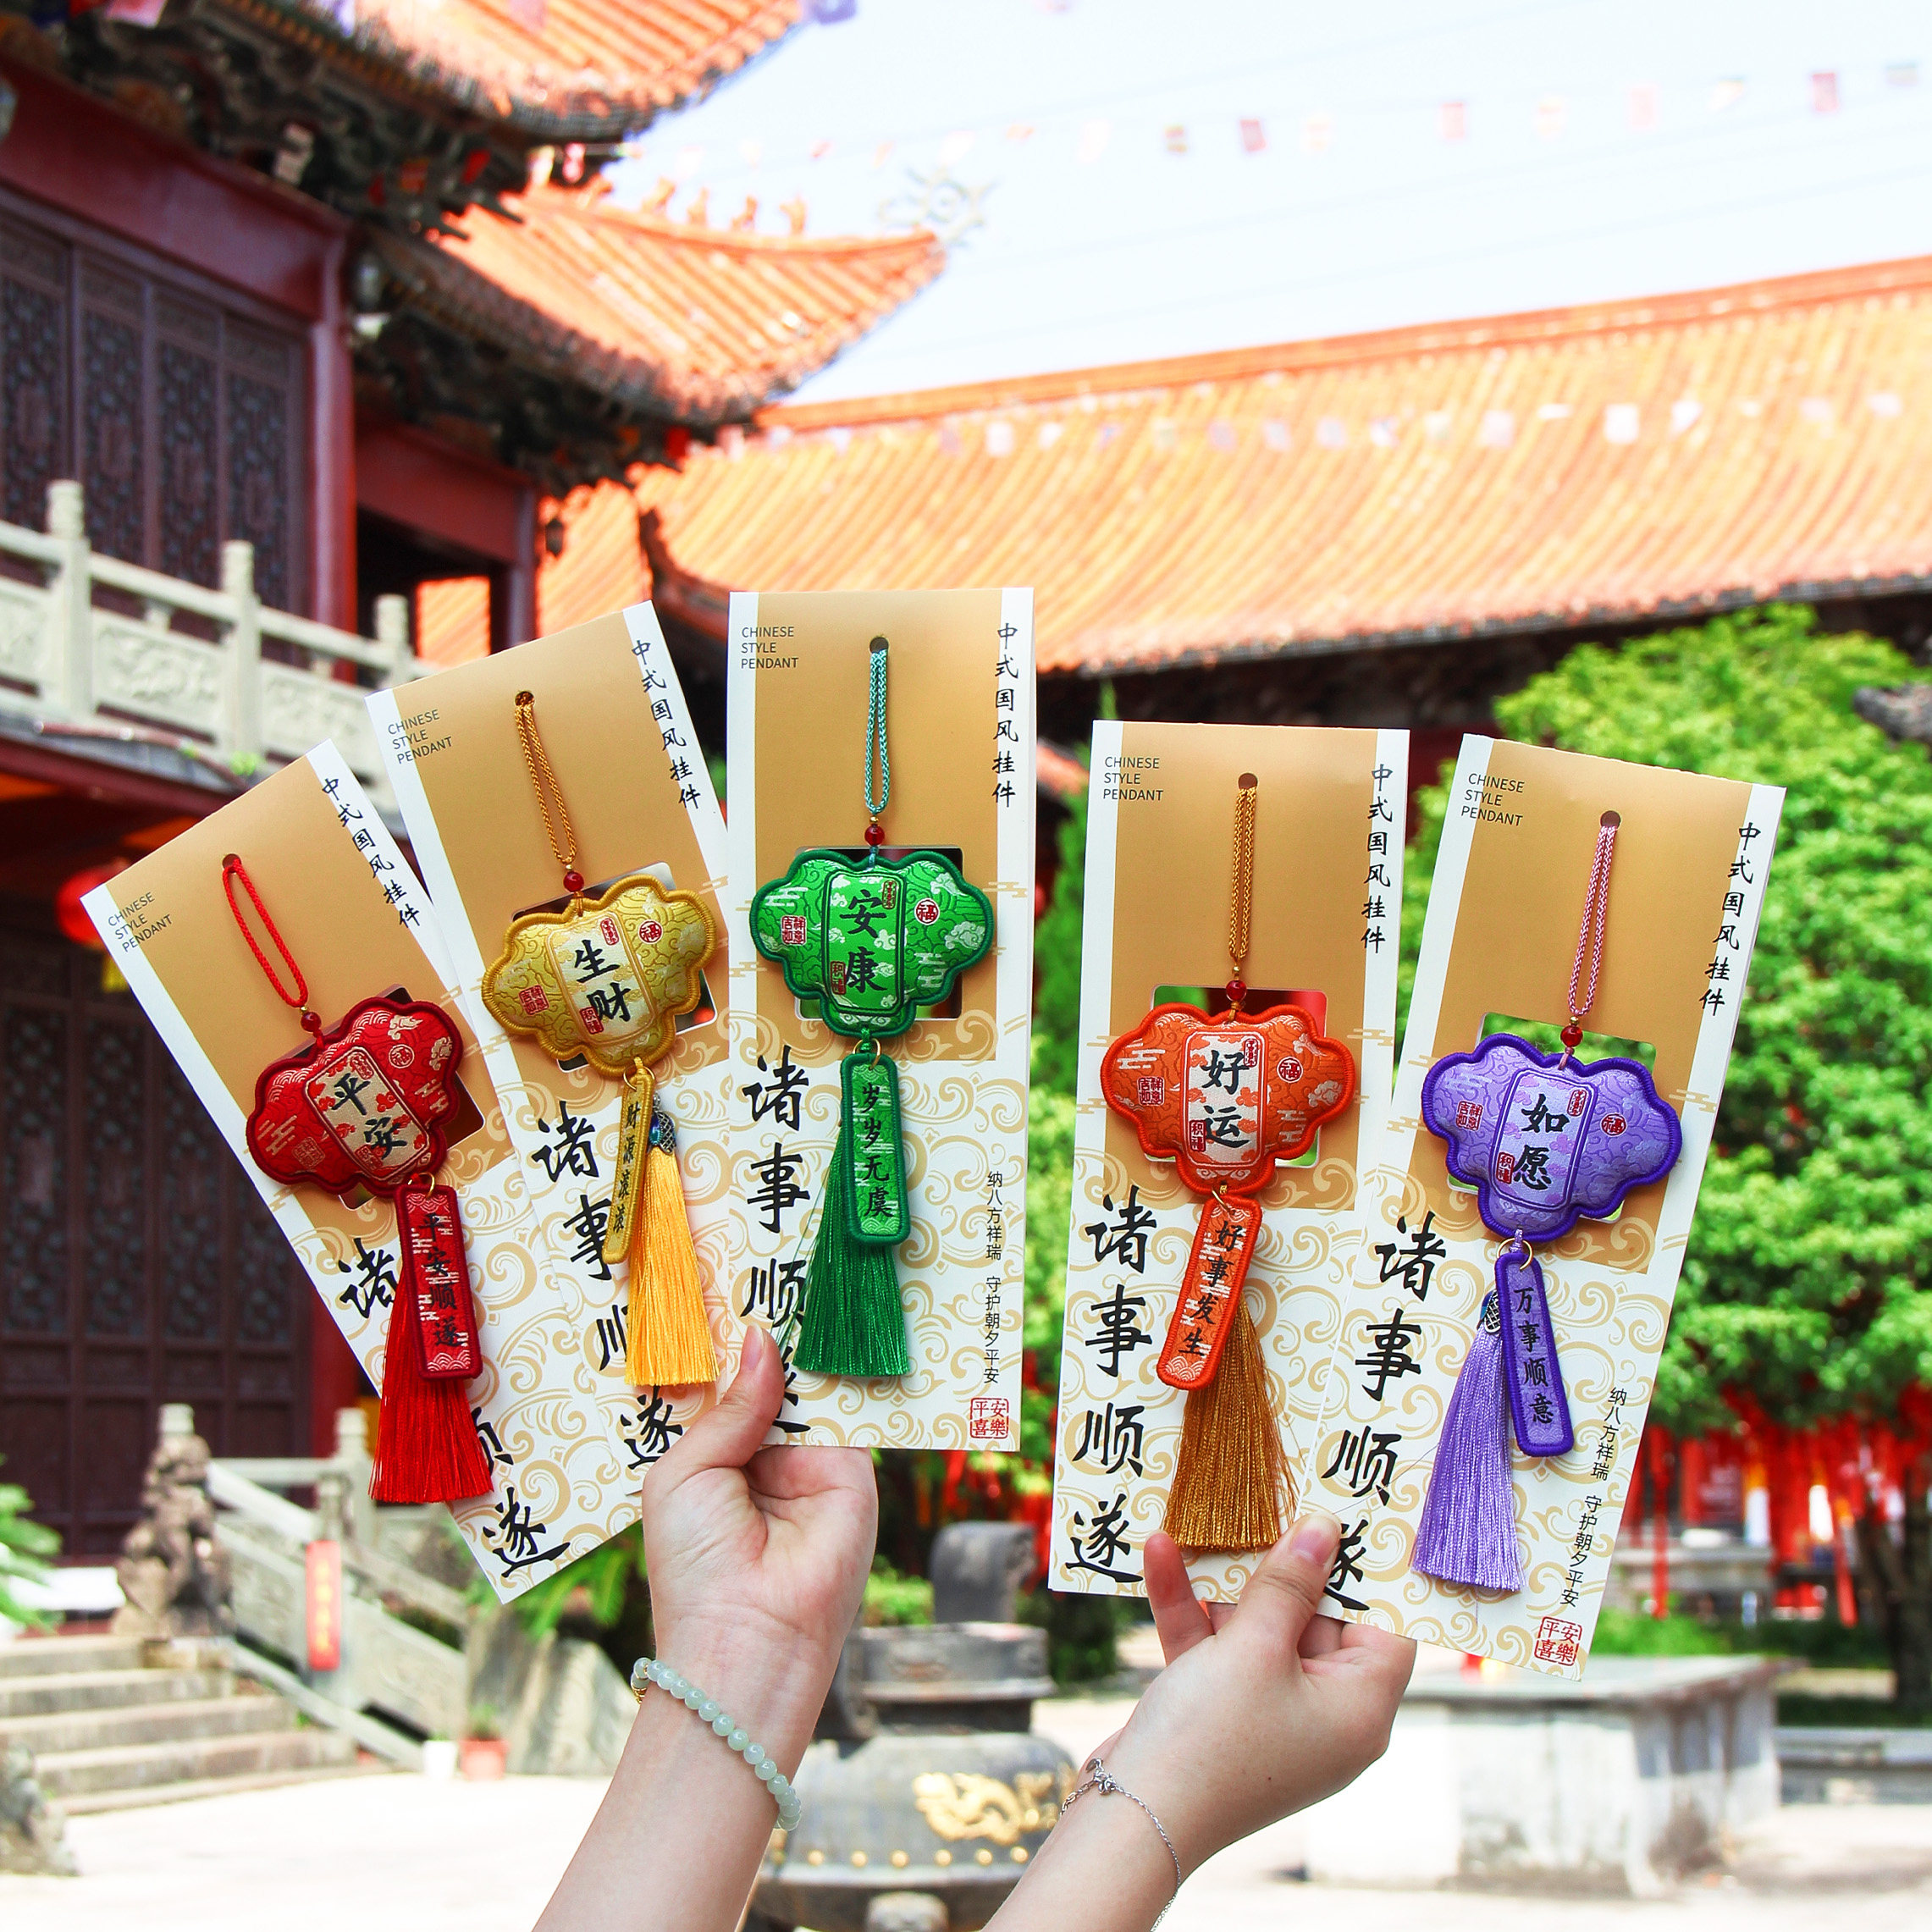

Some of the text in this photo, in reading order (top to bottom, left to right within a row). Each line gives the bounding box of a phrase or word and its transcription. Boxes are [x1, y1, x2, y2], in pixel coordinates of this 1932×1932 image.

[741, 642, 777, 654] STYLE
[741, 656, 798, 670] PENDANT
[742, 626, 795, 639] CHINESE
[387, 709, 440, 735] CHINESE
[392, 730, 428, 750] STYLE
[396, 736, 453, 765] PENDANT
[631, 639, 701, 810] 中式国风挂件
[991, 622, 1019, 809] 中式国风挂件
[1103, 788, 1163, 802] PENDANT
[1104, 773, 1140, 786] STYLE
[1105, 756, 1160, 770] CHINESE
[1465, 789, 1502, 807] STYLE
[1467, 773, 1525, 793] CHINESE
[322, 777, 421, 929] 中式国风挂件
[1461, 805, 1523, 827] PENDANT
[1361, 764, 1393, 954] 中式国风挂件
[108, 891, 155, 928] CHINESE
[114, 914, 147, 940] STYLE
[122, 914, 173, 952] PENDANT
[840, 889, 887, 993] 安康
[1698, 821, 1762, 1017] 中式国风挂件
[575, 939, 631, 1022] 生财
[331, 1073, 407, 1159] 平安
[1201, 1049, 1250, 1148] 好运
[860, 1084, 895, 1218] 岁岁无虞
[1513, 1094, 1570, 1190] 如愿
[418, 1212, 467, 1347] 平安顺遂
[983, 1170, 1003, 1383] 纳八方祥瑞 守护朝夕平安
[1178, 1220, 1244, 1357] 好事发生
[1065, 1184, 1157, 1584] 诸事顺遂
[1514, 1288, 1554, 1425] 万事顺意
[1559, 1386, 1627, 1607] 纳八方祥瑞 守护朝夕平安
